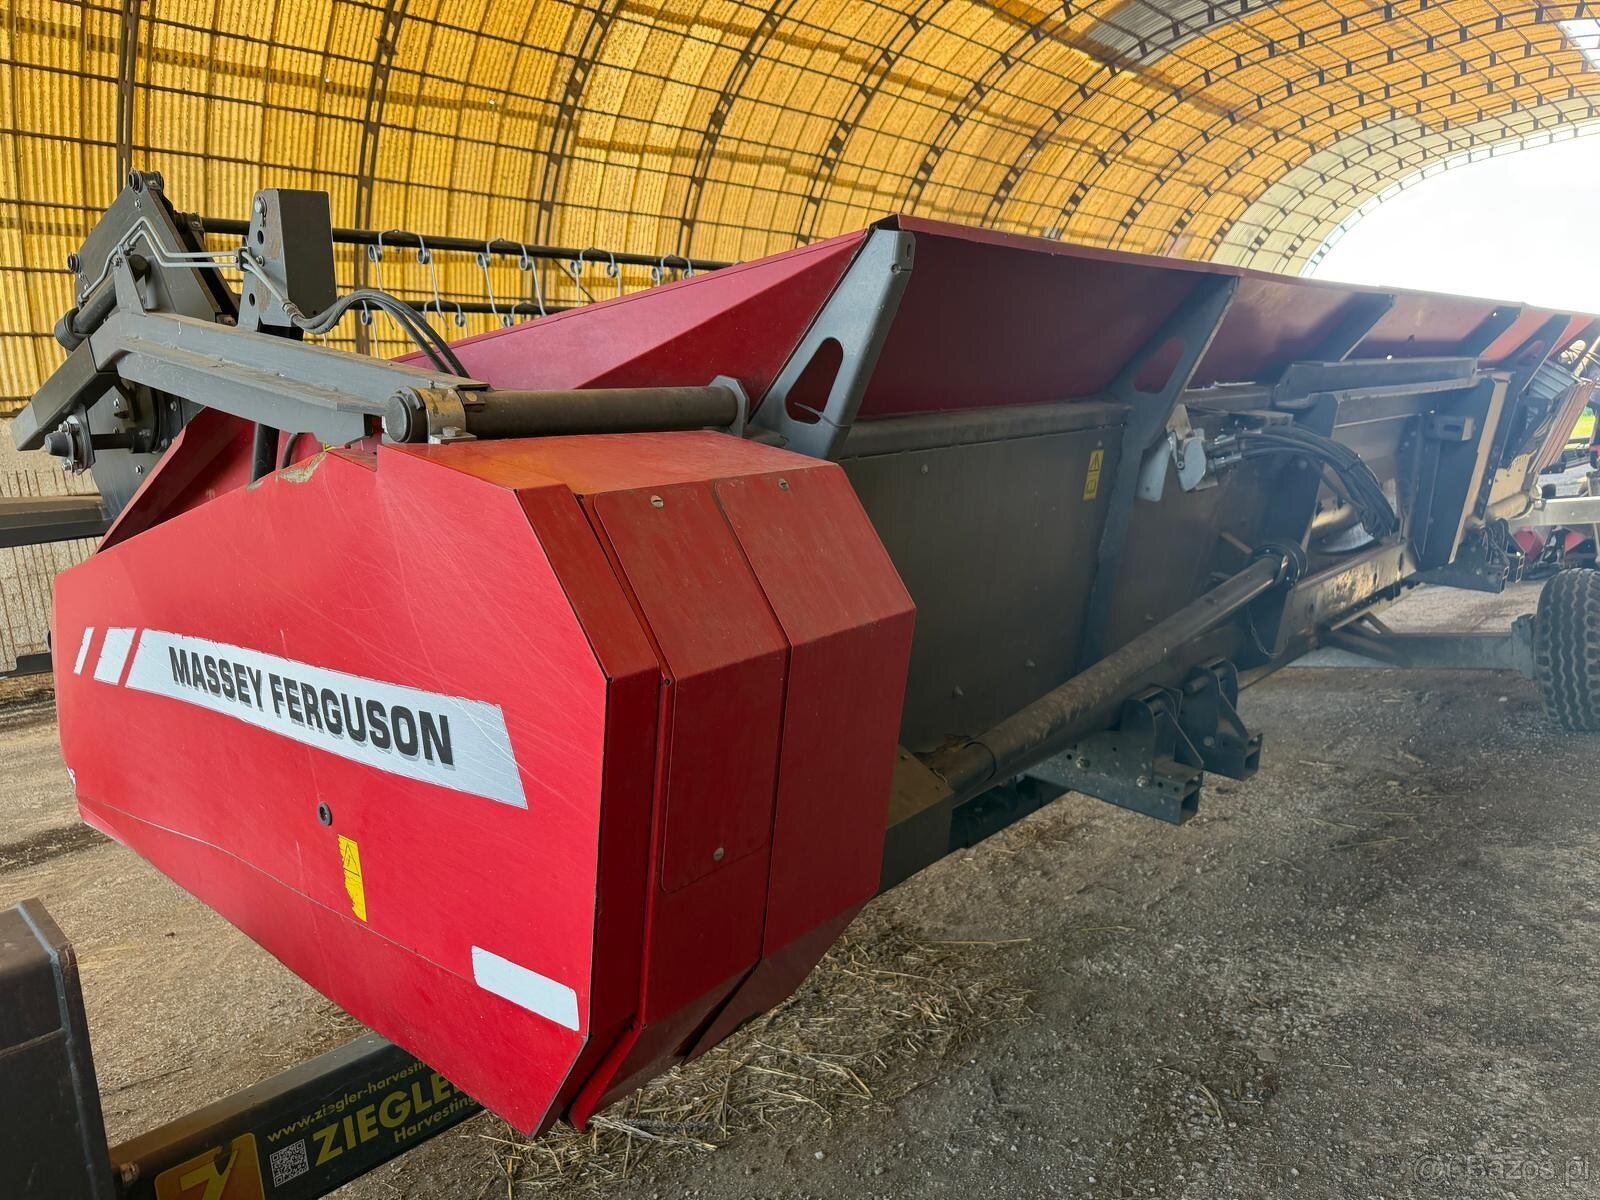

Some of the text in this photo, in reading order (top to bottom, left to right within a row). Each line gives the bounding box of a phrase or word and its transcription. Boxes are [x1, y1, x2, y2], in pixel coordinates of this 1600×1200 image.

[168, 646, 454, 768] MASSEY FERGUSON
[266, 1062, 427, 1143] www.ziegler-harvesti
[313, 1073, 460, 1166] ZIEGLE
